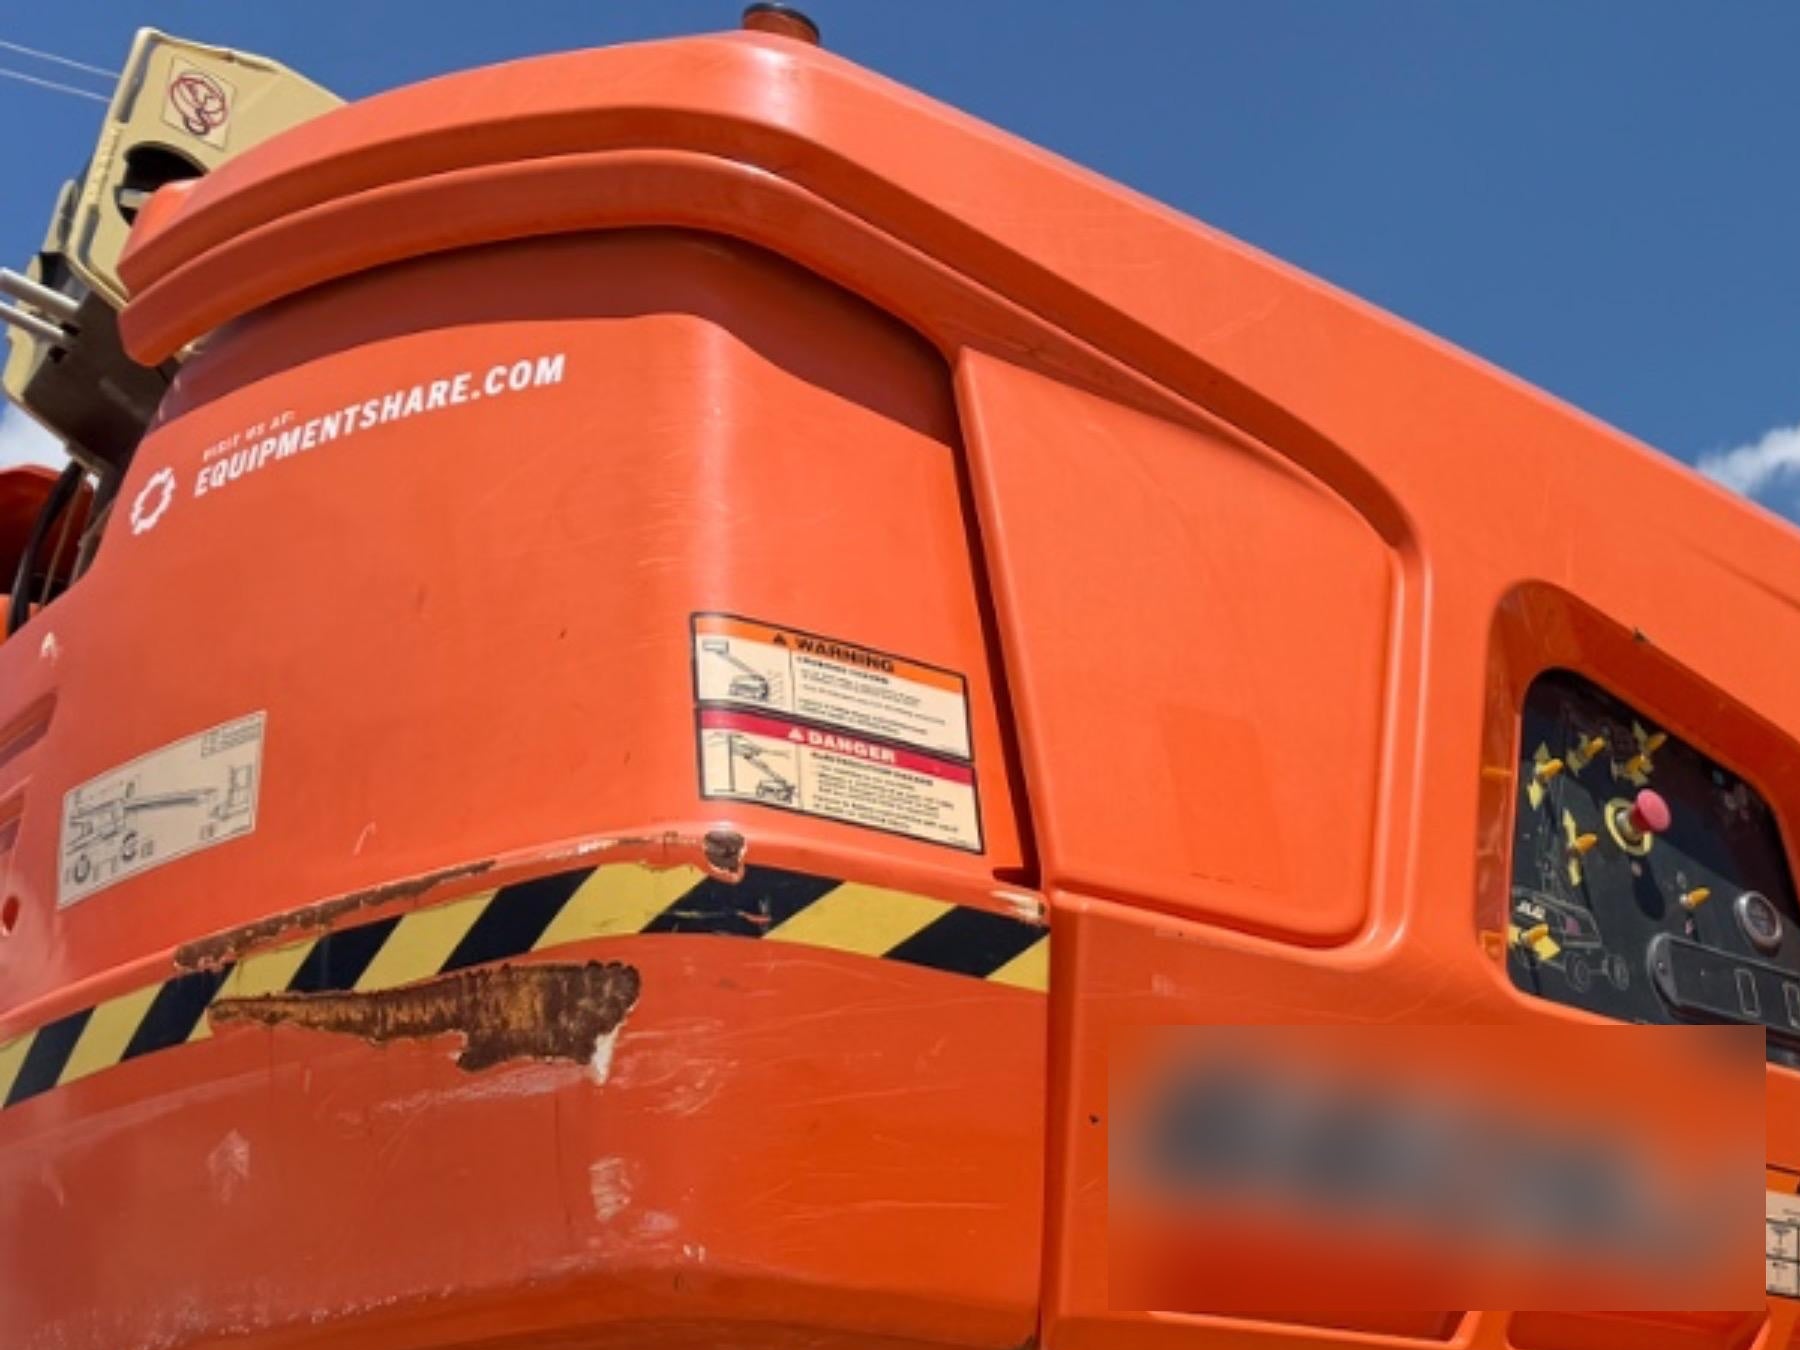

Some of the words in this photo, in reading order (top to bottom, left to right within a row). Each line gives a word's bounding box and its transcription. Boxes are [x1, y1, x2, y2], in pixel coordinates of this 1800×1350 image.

[193, 353, 565, 498] EQUIPMENTSHARE.COM
[796, 636, 894, 673] WARNING
[808, 731, 895, 763] DANGER
